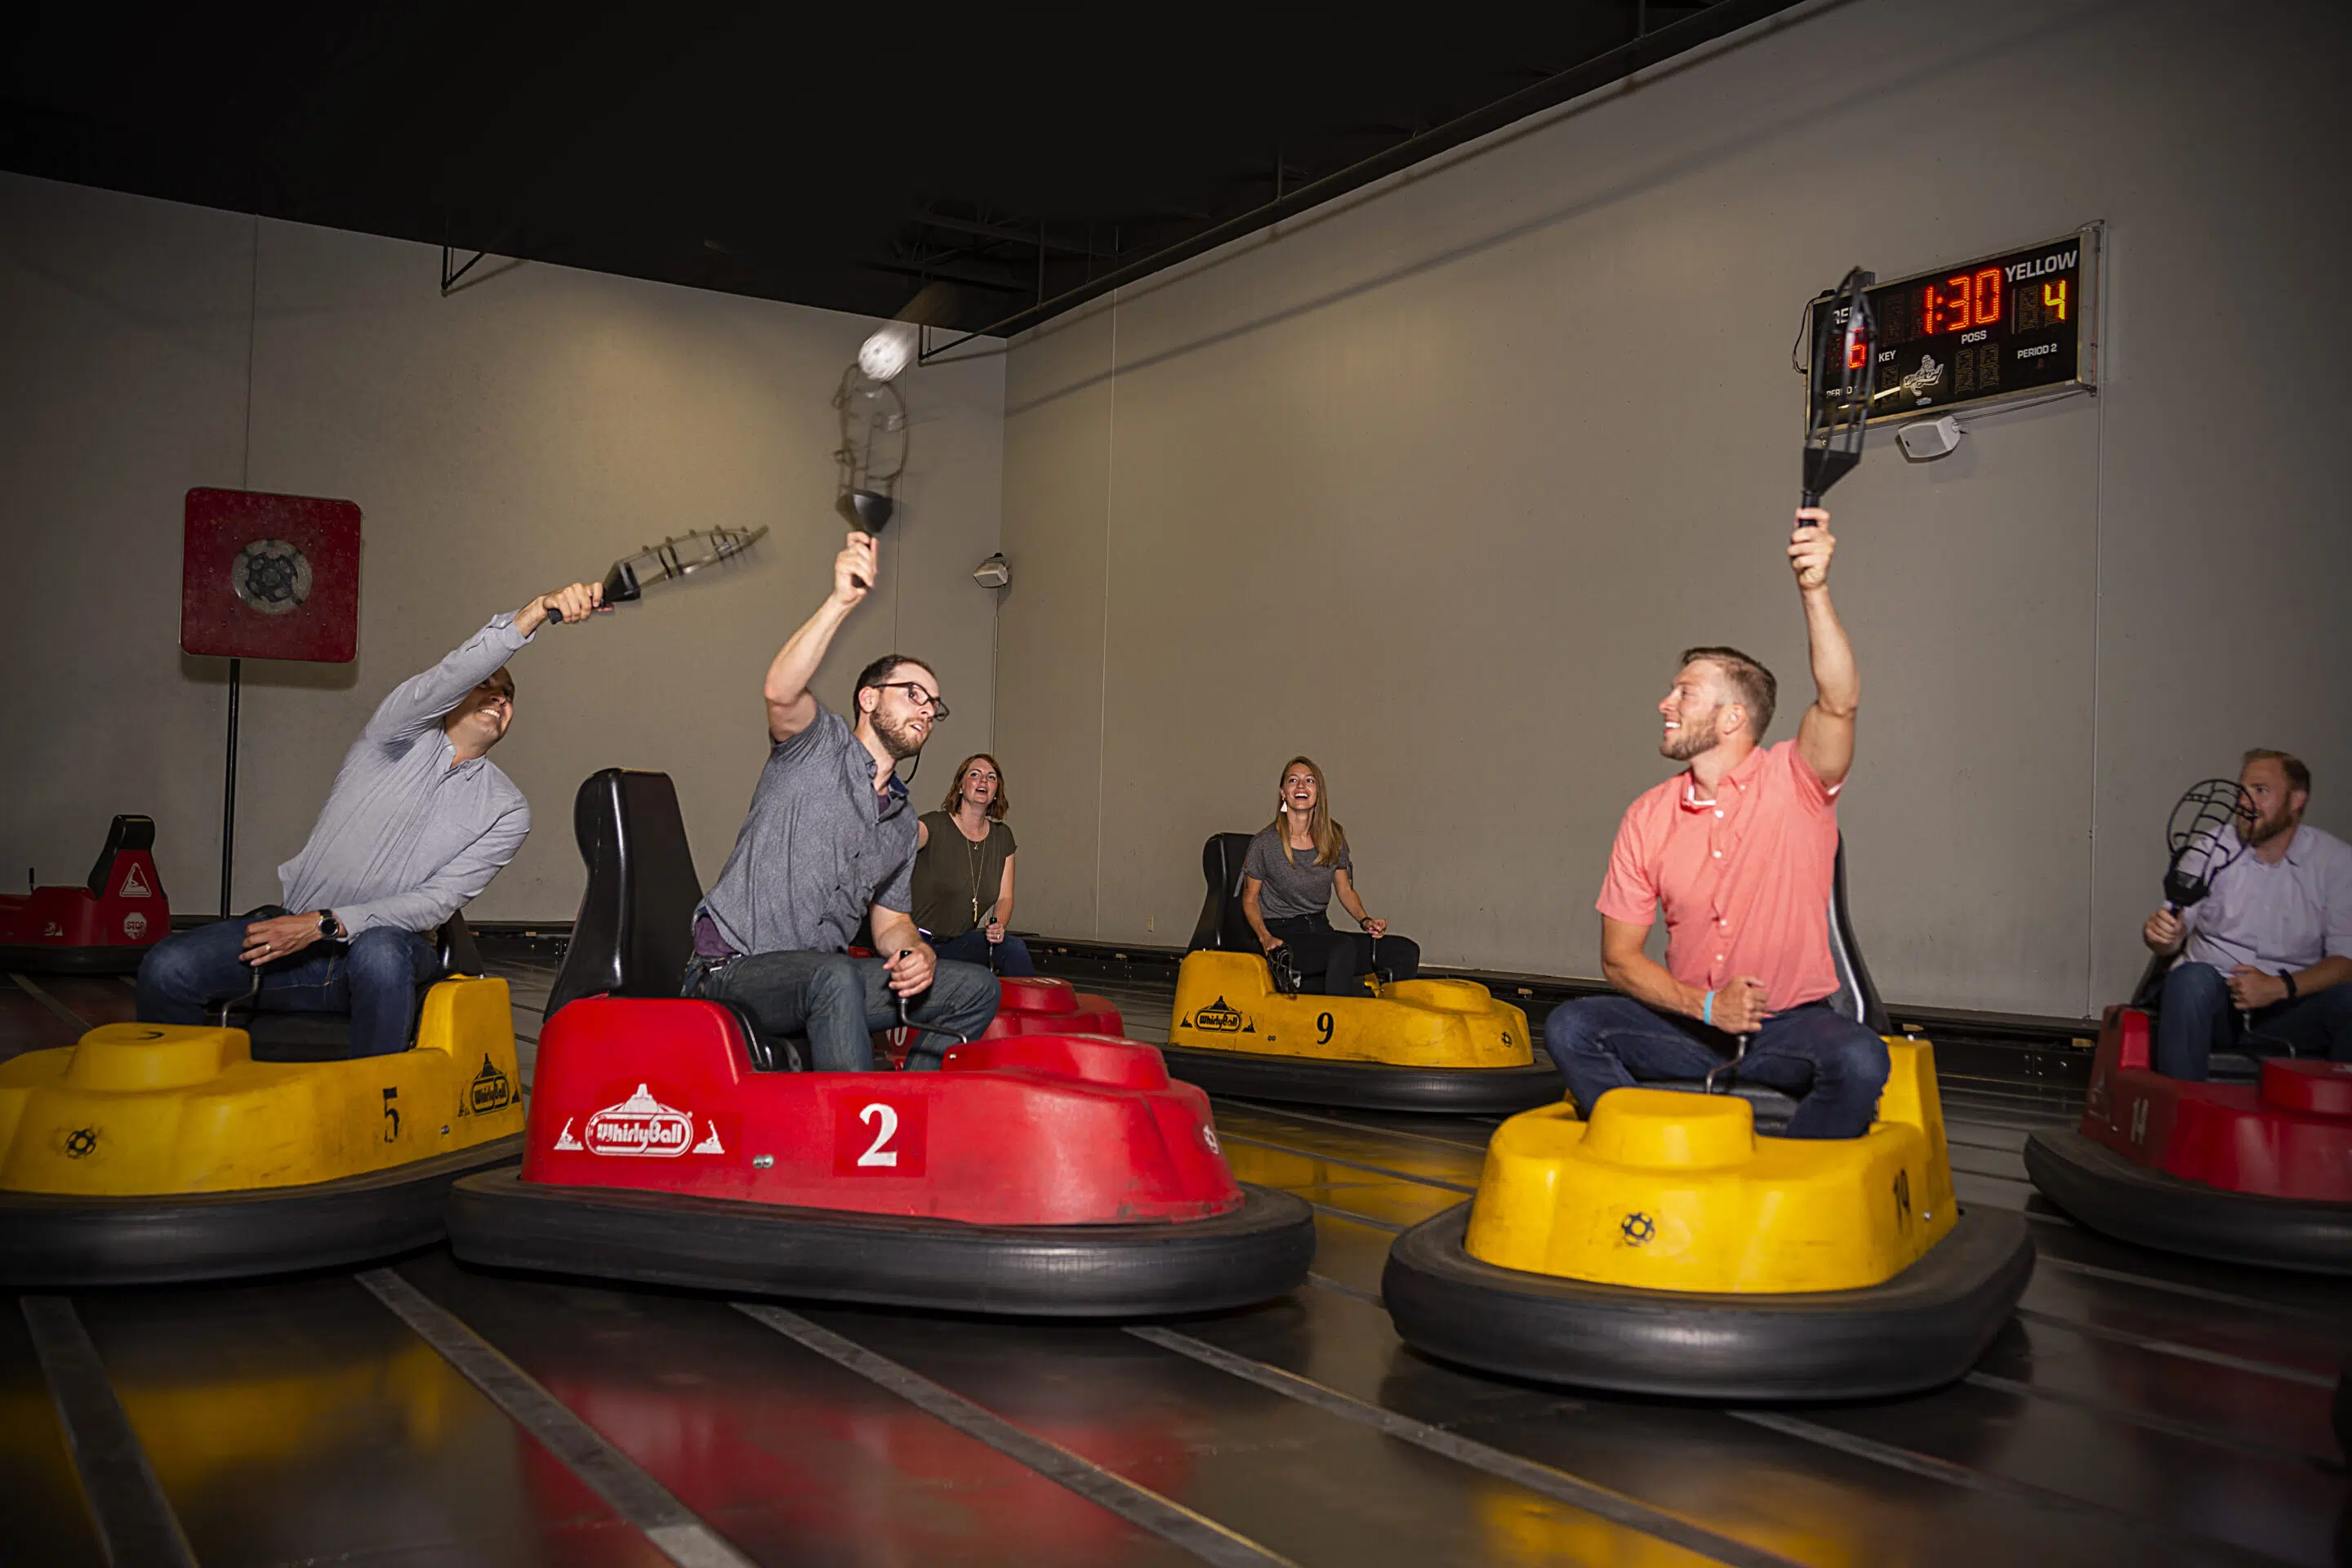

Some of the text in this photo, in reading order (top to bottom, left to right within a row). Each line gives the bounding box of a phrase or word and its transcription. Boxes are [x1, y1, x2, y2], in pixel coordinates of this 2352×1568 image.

[2005, 250, 2078, 283] YELLOW
[1925, 269, 2000, 335] 1:30
[2043, 278, 2066, 321] 4
[1833, 307, 1853, 325] RE
[1961, 329, 1987, 345] POSS
[2017, 343, 2058, 359] PERIOD 2
[126, 921, 145, 930] STOP
[1199, 1013, 1238, 1027] WhirlyBall
[1316, 1012, 1334, 1045] 9
[382, 1086, 400, 1143] 5
[597, 1120, 683, 1146] WhirlyBall
[857, 1102, 898, 1167] 2
